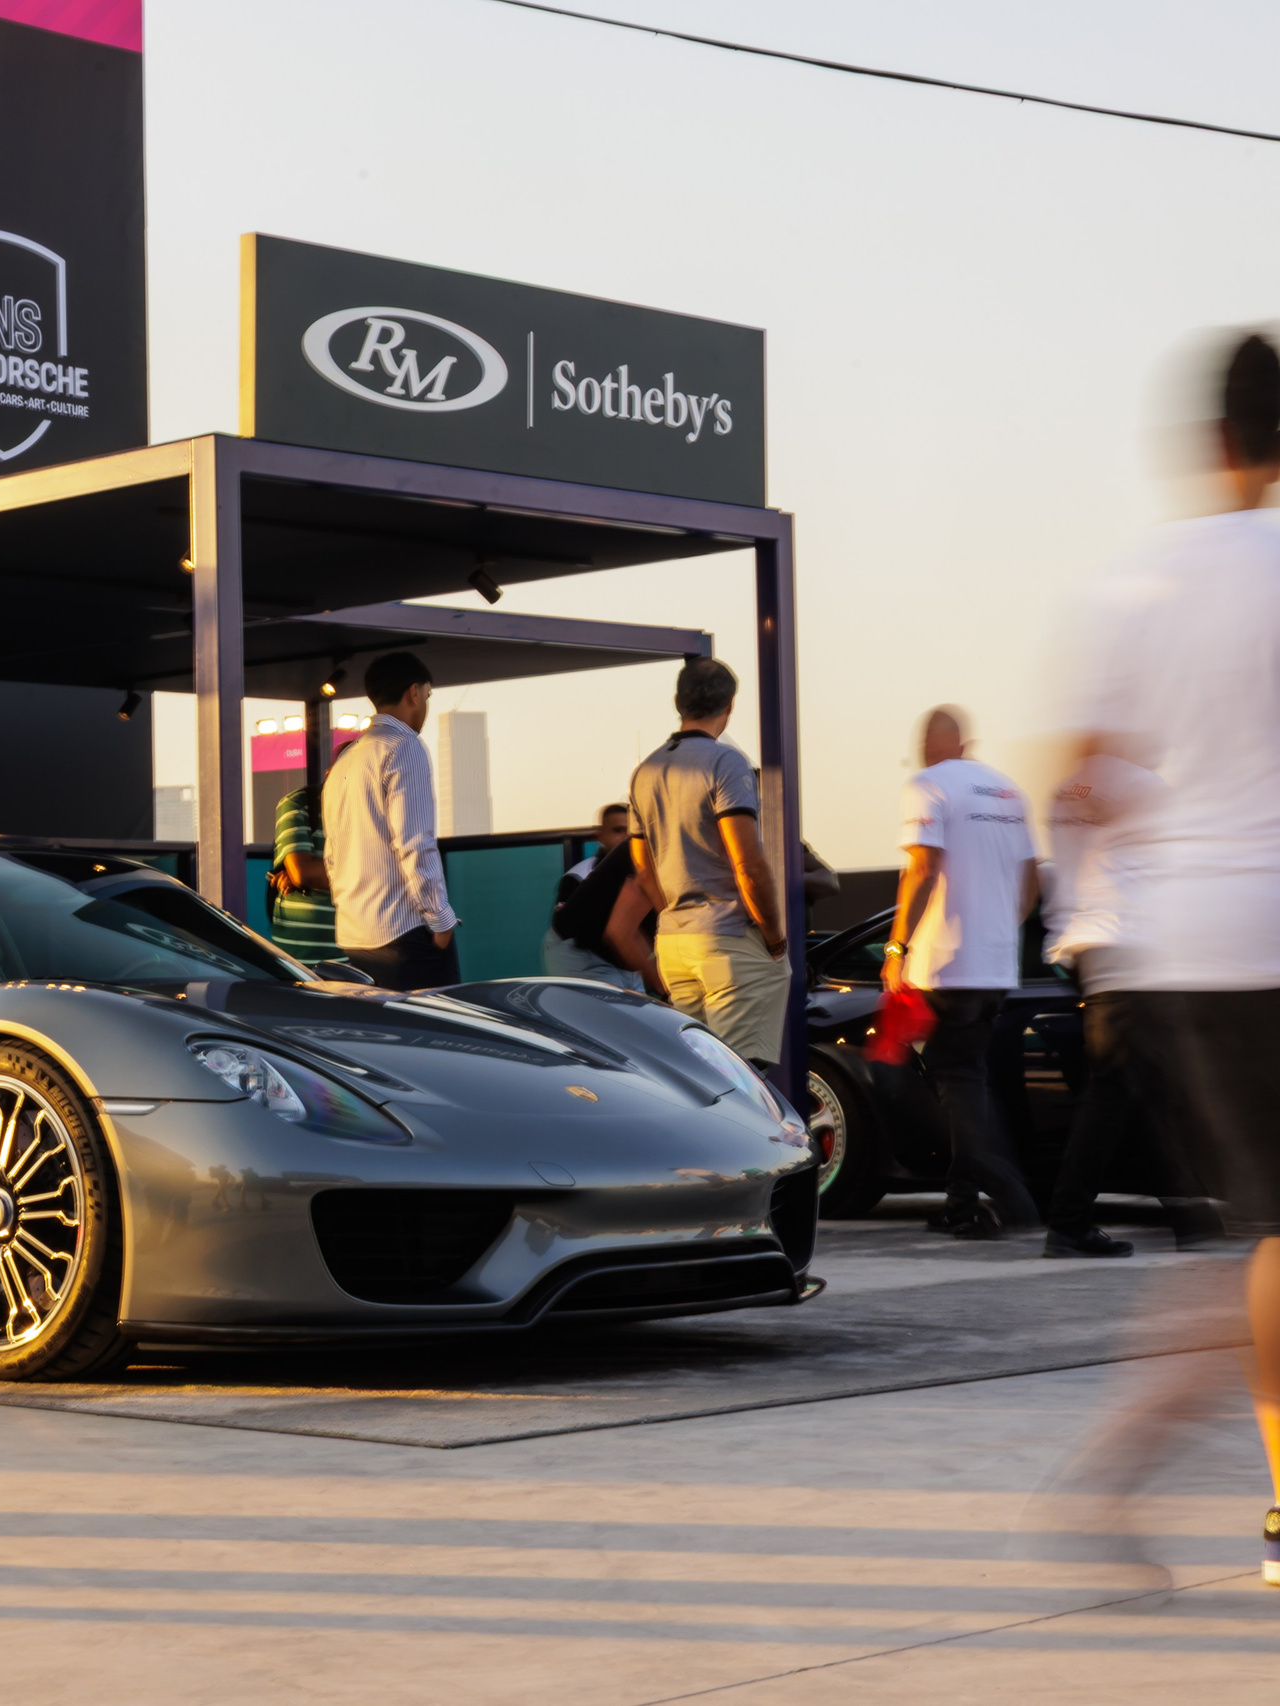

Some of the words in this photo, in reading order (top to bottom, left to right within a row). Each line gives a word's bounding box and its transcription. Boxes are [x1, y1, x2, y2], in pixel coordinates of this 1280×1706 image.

[0, 392, 25, 408] CARS
[27, 396, 46, 411] ART
[50, 400, 90, 418] CULTURE
[348, 317, 458, 401] RM
[551, 359, 732, 443] Sotheby's
[47, 1084, 96, 1173] MICHELIN
